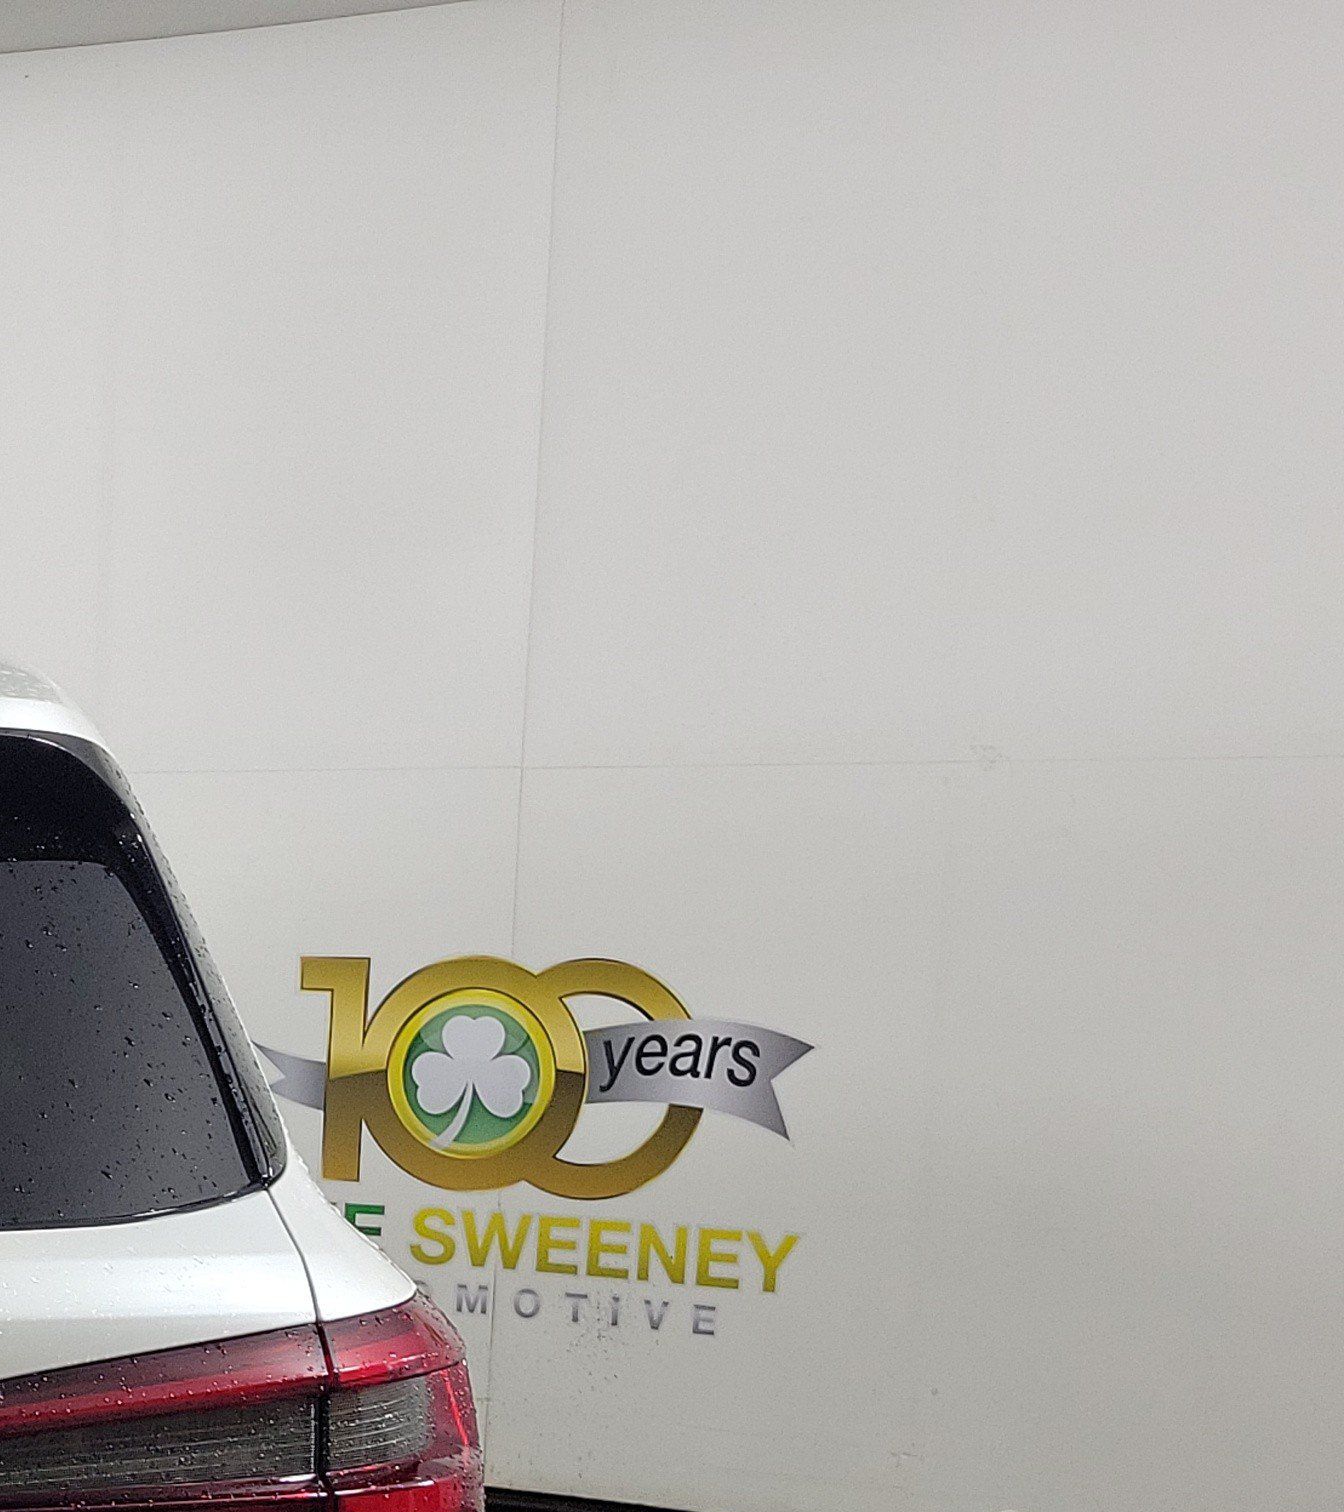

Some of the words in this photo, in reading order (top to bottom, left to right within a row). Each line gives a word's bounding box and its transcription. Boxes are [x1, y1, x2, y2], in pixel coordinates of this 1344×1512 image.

[300, 954, 704, 1200] 100
[599, 1033, 761, 1093] years
[410, 1205, 799, 1293] SWEENEY
[455, 1282, 717, 1336] MOTIVE
